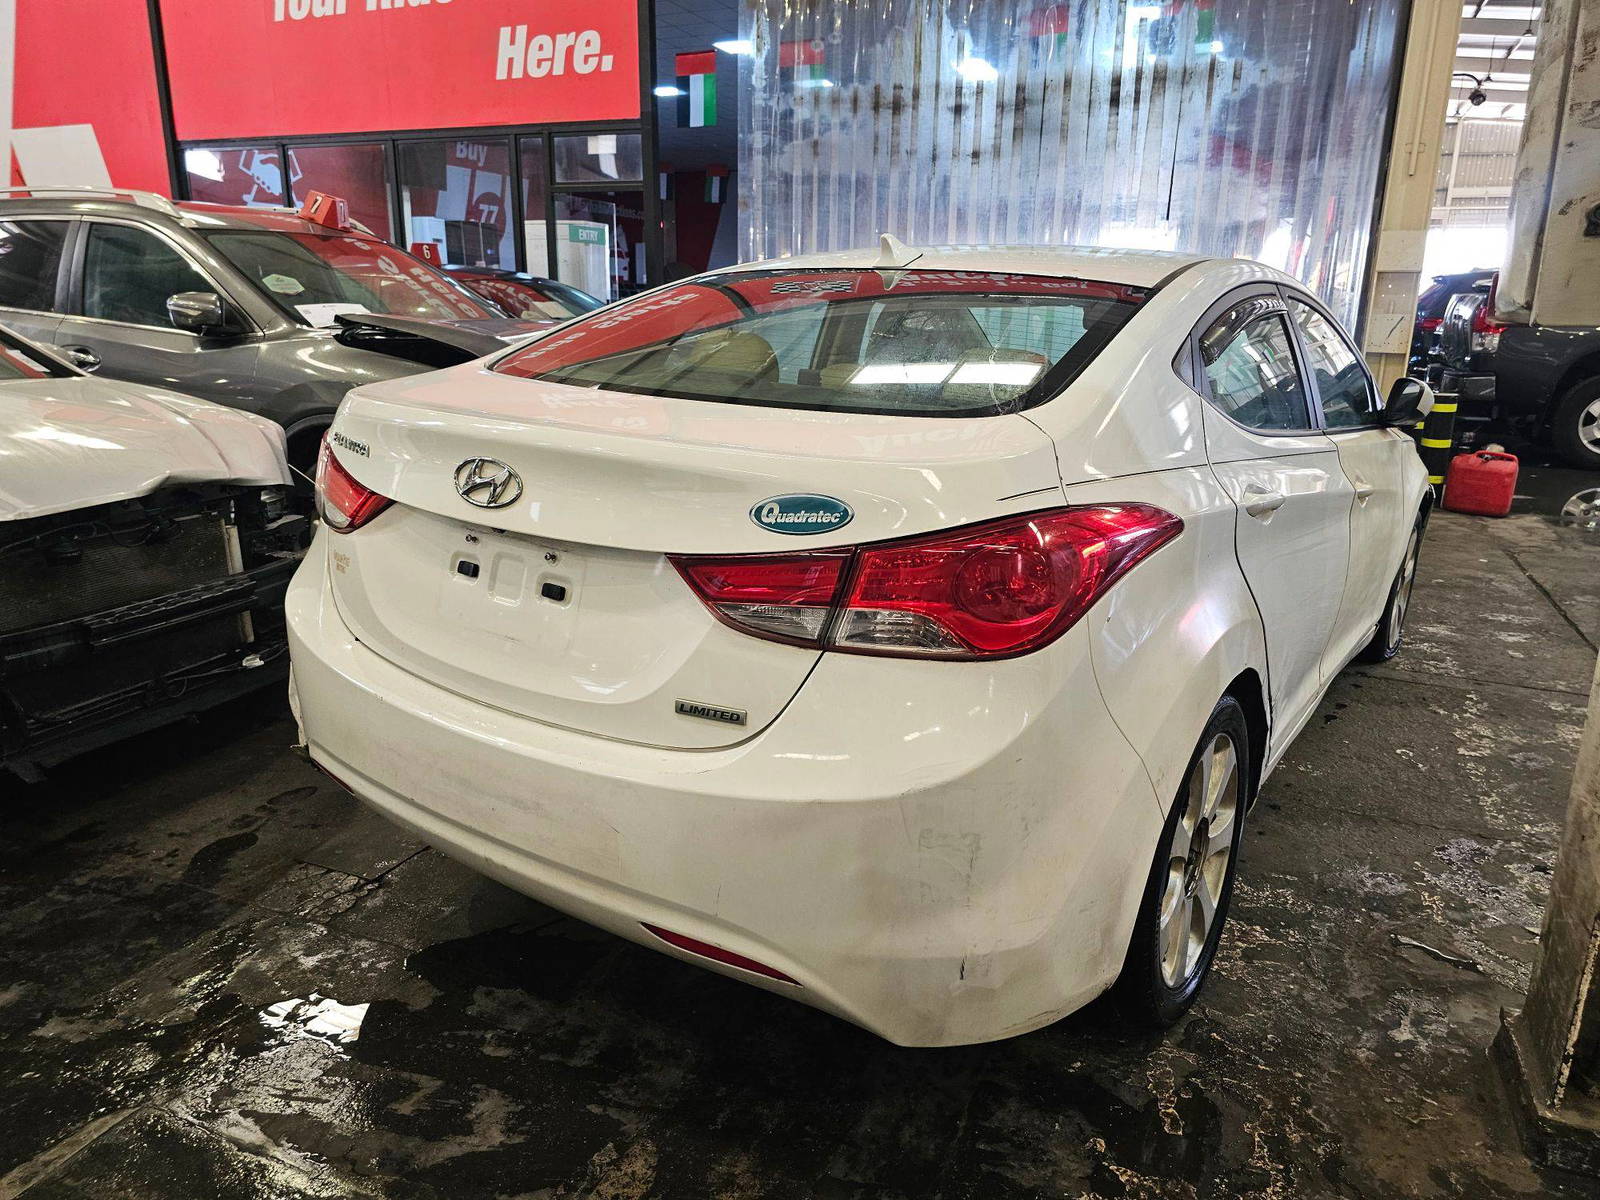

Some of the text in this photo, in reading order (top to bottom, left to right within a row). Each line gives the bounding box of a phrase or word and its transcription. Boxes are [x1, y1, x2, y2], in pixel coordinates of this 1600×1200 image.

[496, 24, 614, 80] Here.
[456, 141, 488, 168] Buy
[310, 196, 323, 214] 7
[578, 228, 599, 242] ENTRY
[422, 244, 432, 259] 6
[760, 502, 843, 525] Quadratec
[678, 702, 741, 723] LIMITED
